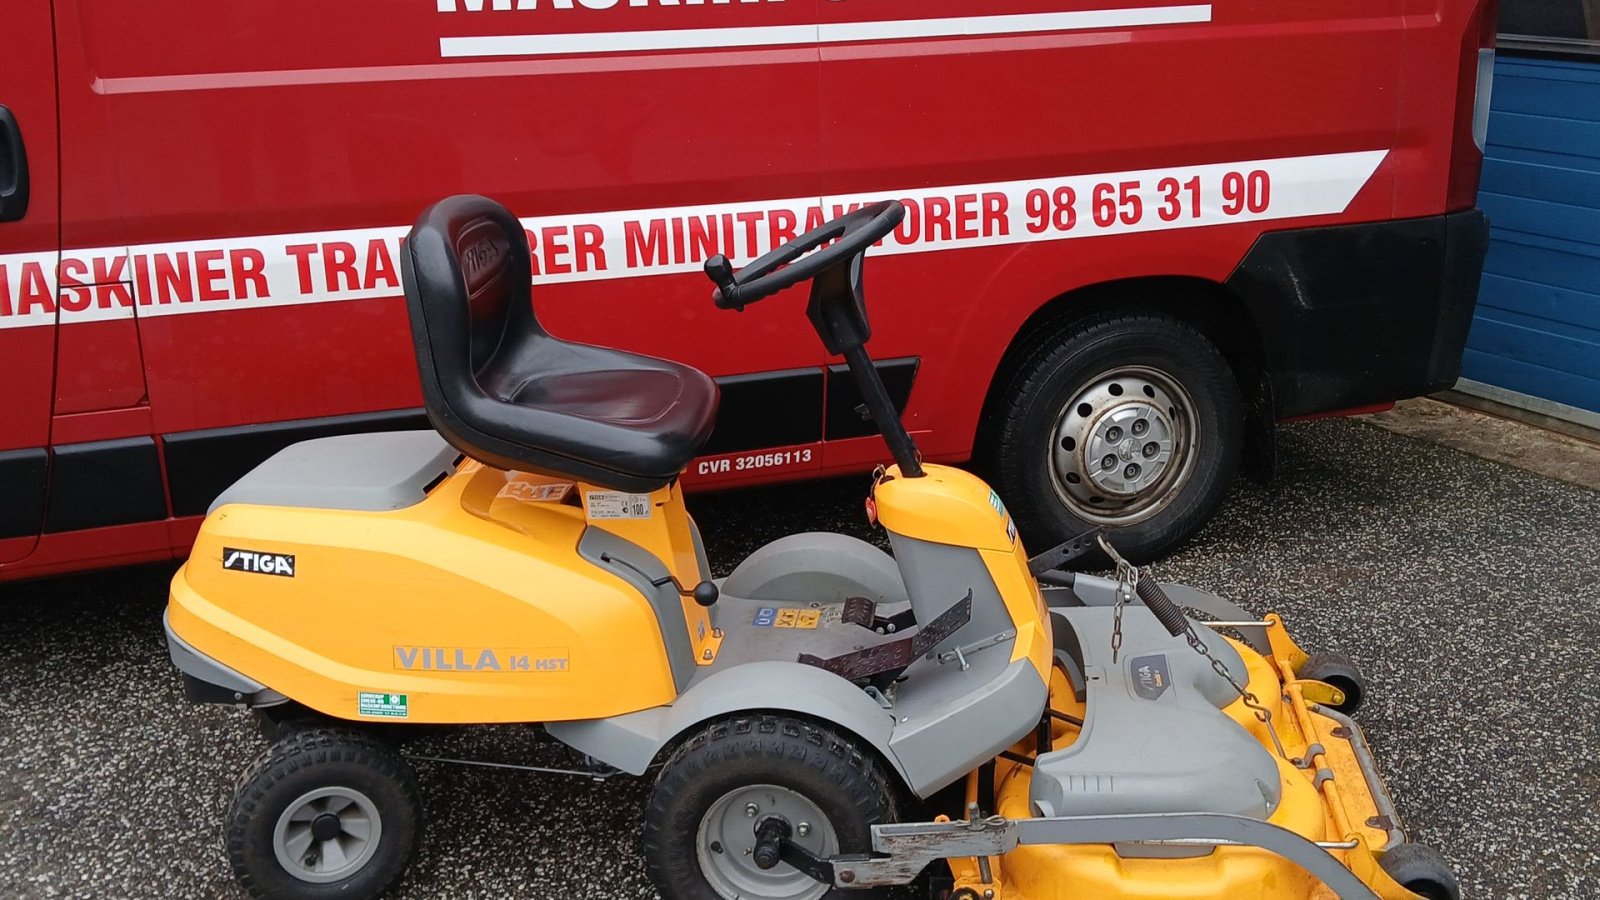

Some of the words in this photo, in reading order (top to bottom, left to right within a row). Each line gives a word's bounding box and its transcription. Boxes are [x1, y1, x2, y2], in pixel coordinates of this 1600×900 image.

[1026, 186, 1076, 234] 98
[1093, 181, 1142, 227] 65
[1157, 175, 1201, 221] 31
[1222, 169, 1271, 215] 90
[698, 459, 731, 475] CVR
[735, 449, 812, 471] 32056113
[224, 551, 293, 575] STIGA
[396, 646, 502, 671] VILLA
[510, 655, 531, 671] 14
[535, 658, 568, 670] HST
